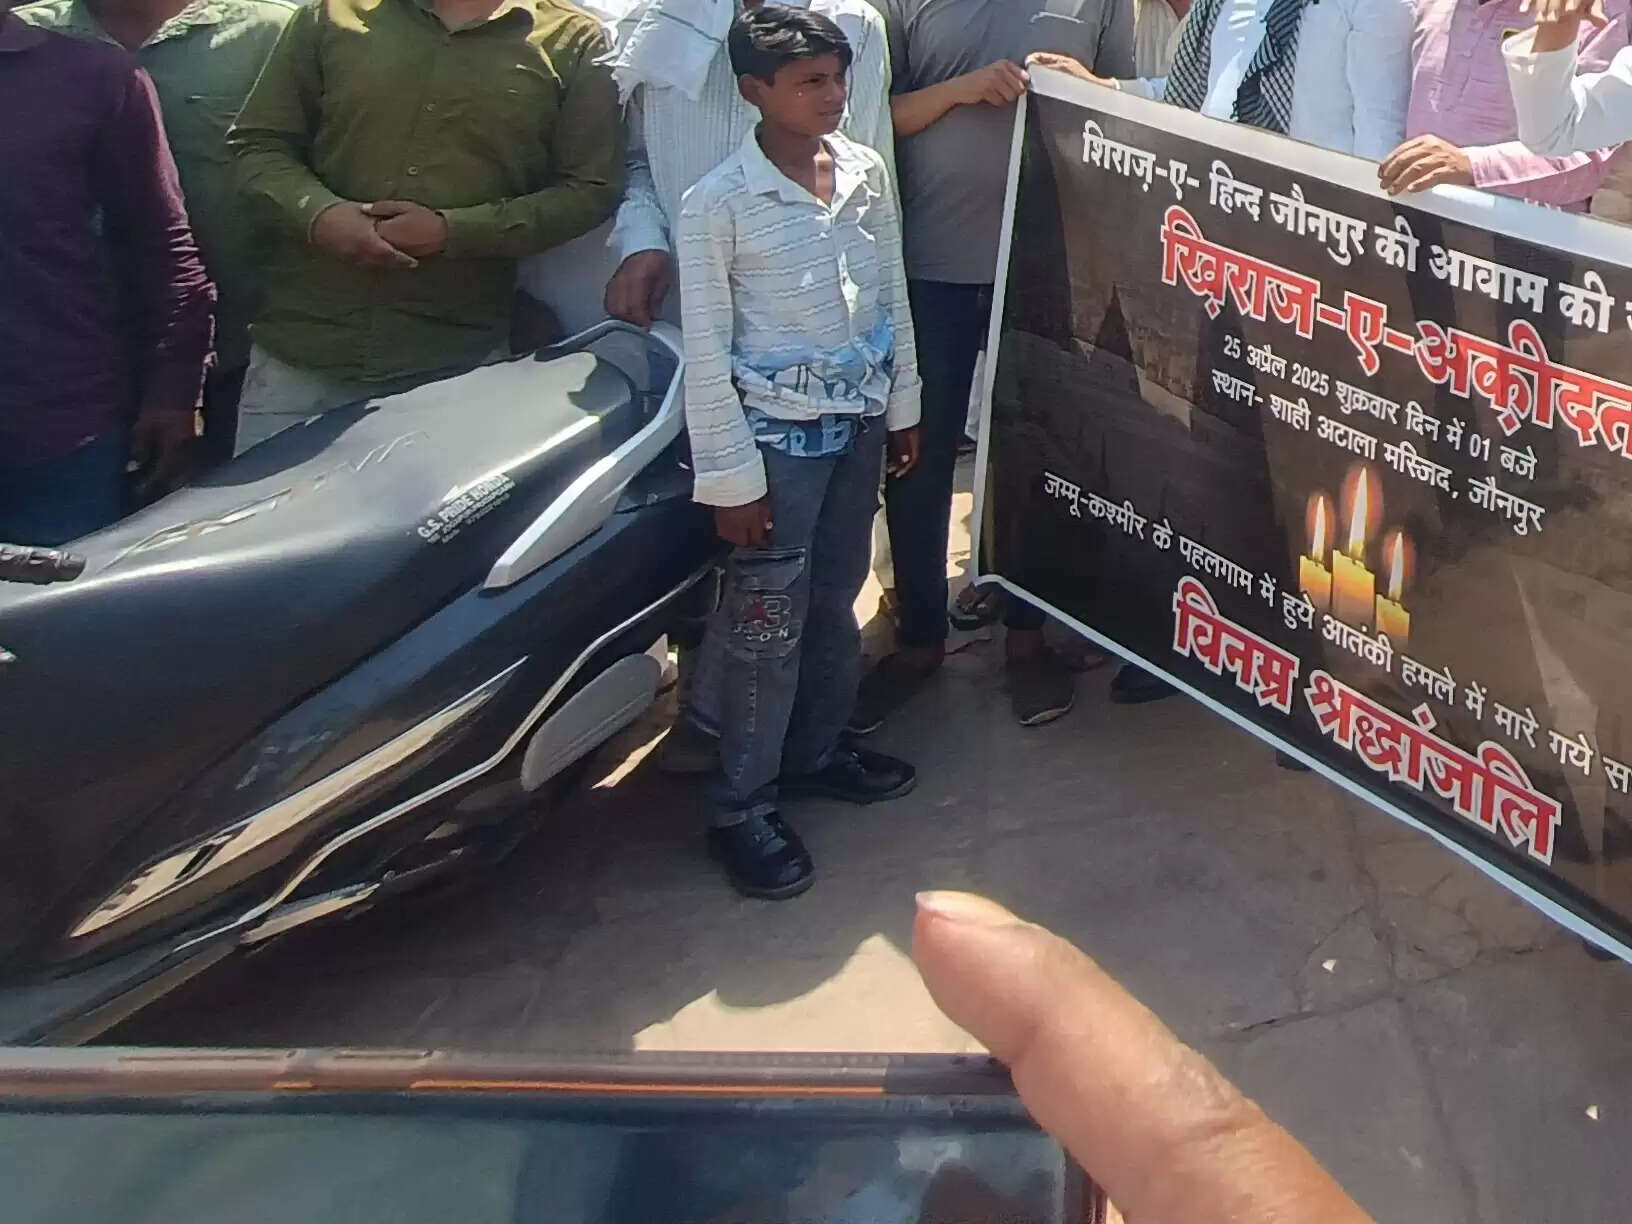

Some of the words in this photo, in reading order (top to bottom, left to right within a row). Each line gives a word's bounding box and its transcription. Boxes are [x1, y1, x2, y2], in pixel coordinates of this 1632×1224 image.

[1209, 160, 1263, 222] हिन्द
[1270, 184, 1368, 266] जौनपुर
[1374, 216, 1420, 272] की
[1429, 245, 1549, 313] आवाम
[1558, 270, 1615, 333] की
[1223, 334, 1241, 359] 25
[1246, 344, 1287, 380] अप्रैल
[1291, 363, 1330, 397] 2025
[1335, 379, 1400, 425] शुक्रवार
[1405, 401, 1440, 442] दिन
[1446, 417, 1466, 451] में
[1469, 433, 1491, 462] 01
[1500, 445, 1538, 481] बजे
[1270, 394, 1311, 432] शाही
[1317, 415, 1378, 461] अटाला
[1468, 476, 1546, 537] जौनपुर
[1044, 472, 1148, 540] जम्मू-कश्मीर
[1152, 518, 1174, 552] के
[1179, 534, 1254, 596] पहलगाम
[1259, 572, 1278, 608] में
[1282, 591, 1316, 630] हुये
[1322, 612, 1394, 673] आतंकी
[1401, 655, 1456, 706] हमले
[1464, 681, 1488, 721] में
[1493, 701, 1540, 749] मारे
[1547, 728, 1595, 776] गये
[1172, 575, 1300, 715] विनम्र
[1303, 669, 1563, 866] श्रद्धांजलि
